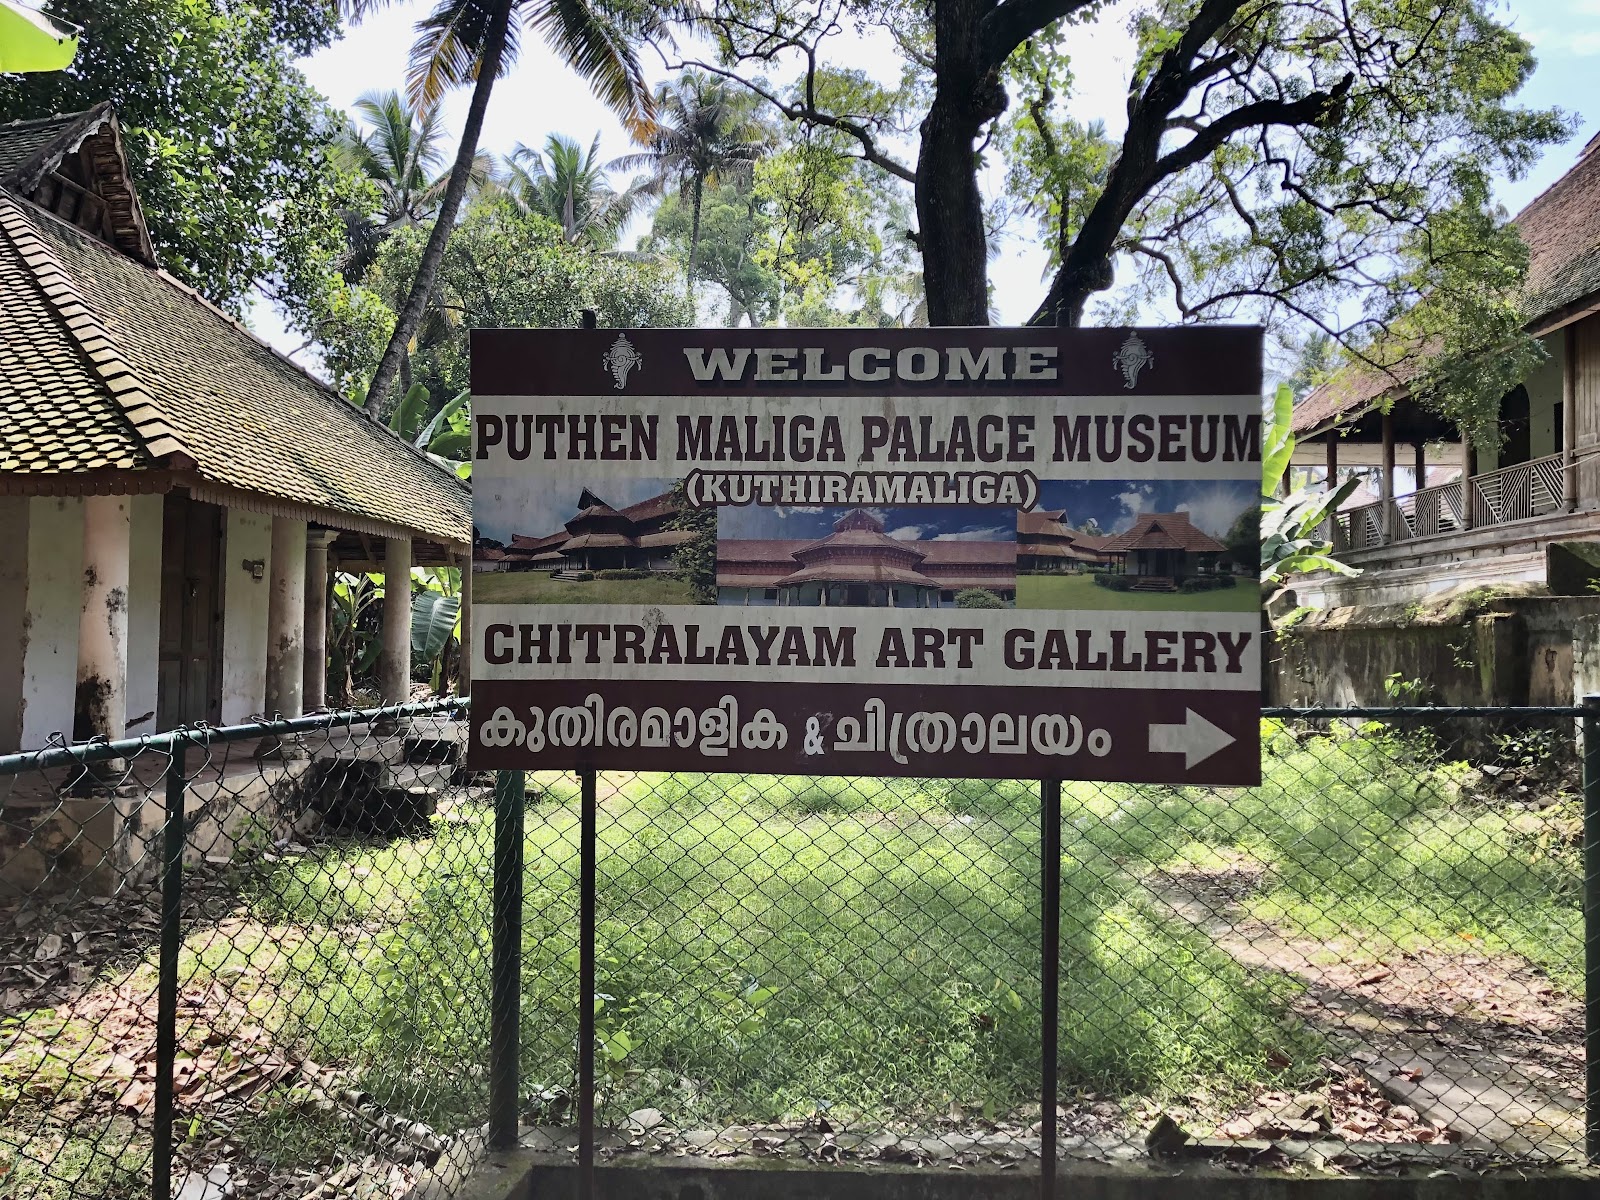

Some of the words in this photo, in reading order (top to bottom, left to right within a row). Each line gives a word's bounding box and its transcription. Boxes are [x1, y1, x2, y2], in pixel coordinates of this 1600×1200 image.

[682, 346, 1059, 383] WELCOME
[475, 414, 659, 461] PUTHEN
[676, 414, 846, 462] MALIGA
[862, 415, 1035, 462] PALACE
[1053, 414, 1261, 462] MUSEUM
[686, 470, 1037, 509] (KUTHIRAMALIGA)
[483, 624, 857, 667] CHITRALAYAM
[875, 627, 984, 669] ART
[1003, 629, 1252, 674] GALLERY
[479, 693, 789, 757] കുതിരമാളിക
[803, 716, 826, 756] &
[833, 697, 1113, 765] ചിത്രാലയം
